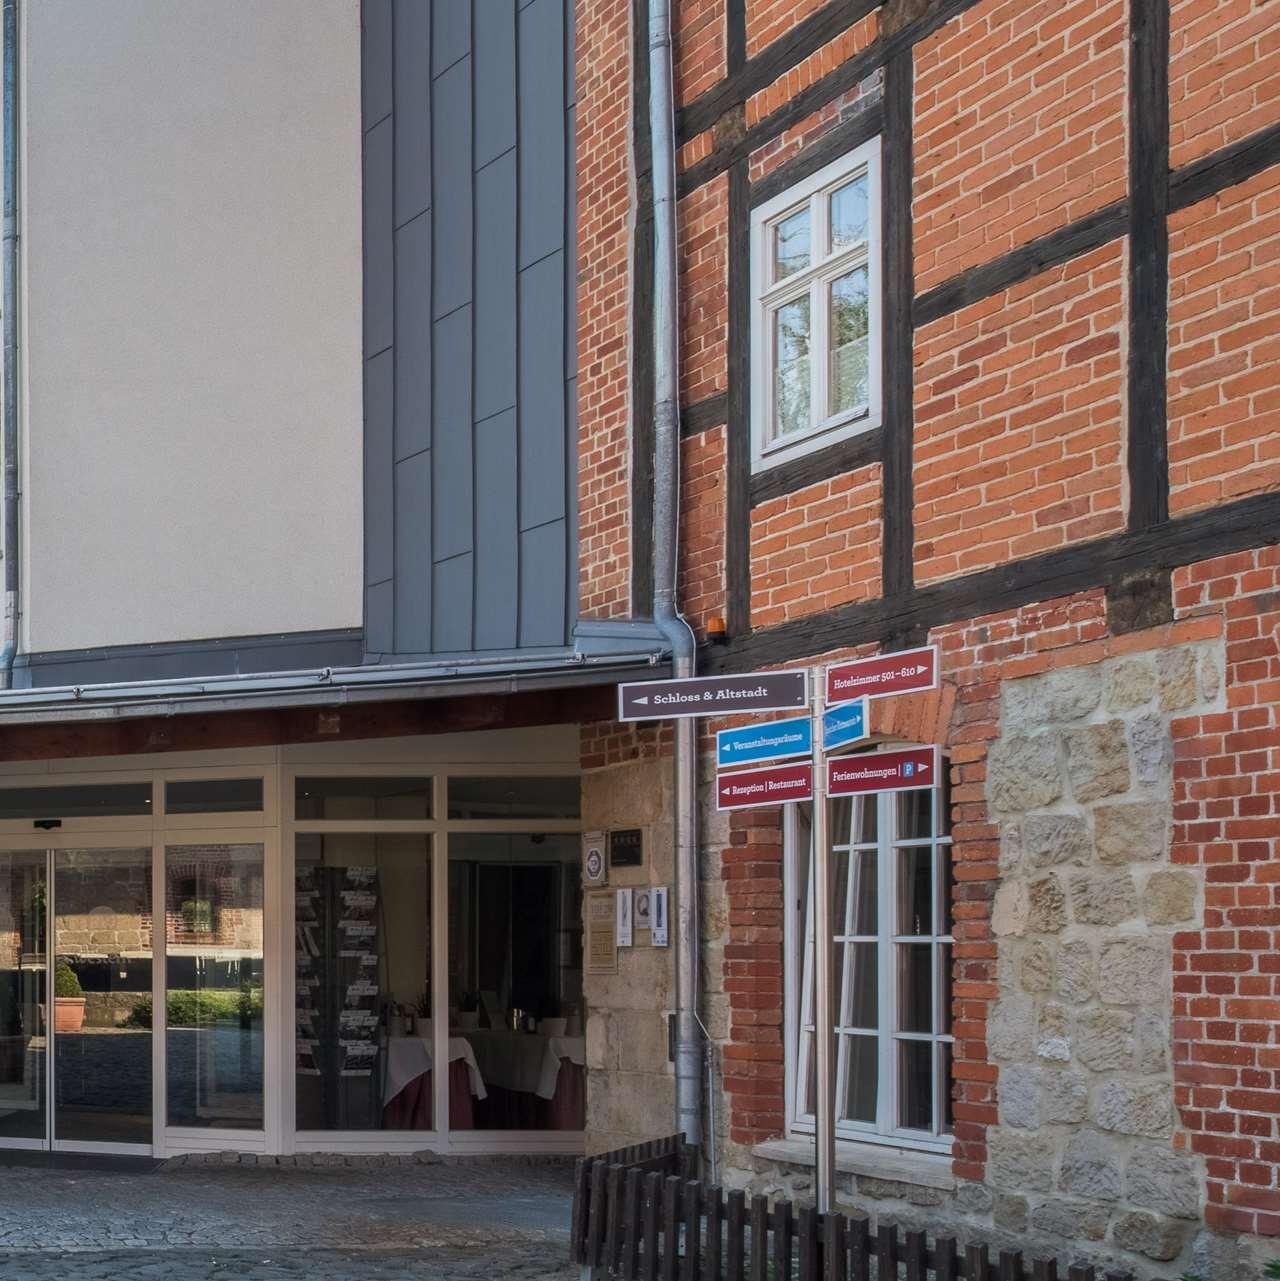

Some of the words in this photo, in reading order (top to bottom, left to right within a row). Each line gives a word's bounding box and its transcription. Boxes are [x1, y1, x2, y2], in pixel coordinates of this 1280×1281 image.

[833, 676, 880, 690] Hotelzimmer
[653, 692, 701, 704] Schloss
[703, 691, 713, 700] &
[715, 686, 768, 700] Altstadt
[733, 733, 803, 750] Veranstaltungsräume
[832, 767, 897, 781] Ferienwohnungen
[732, 783, 765, 796] Rezeption
[768, 778, 807, 790] Restaurant
